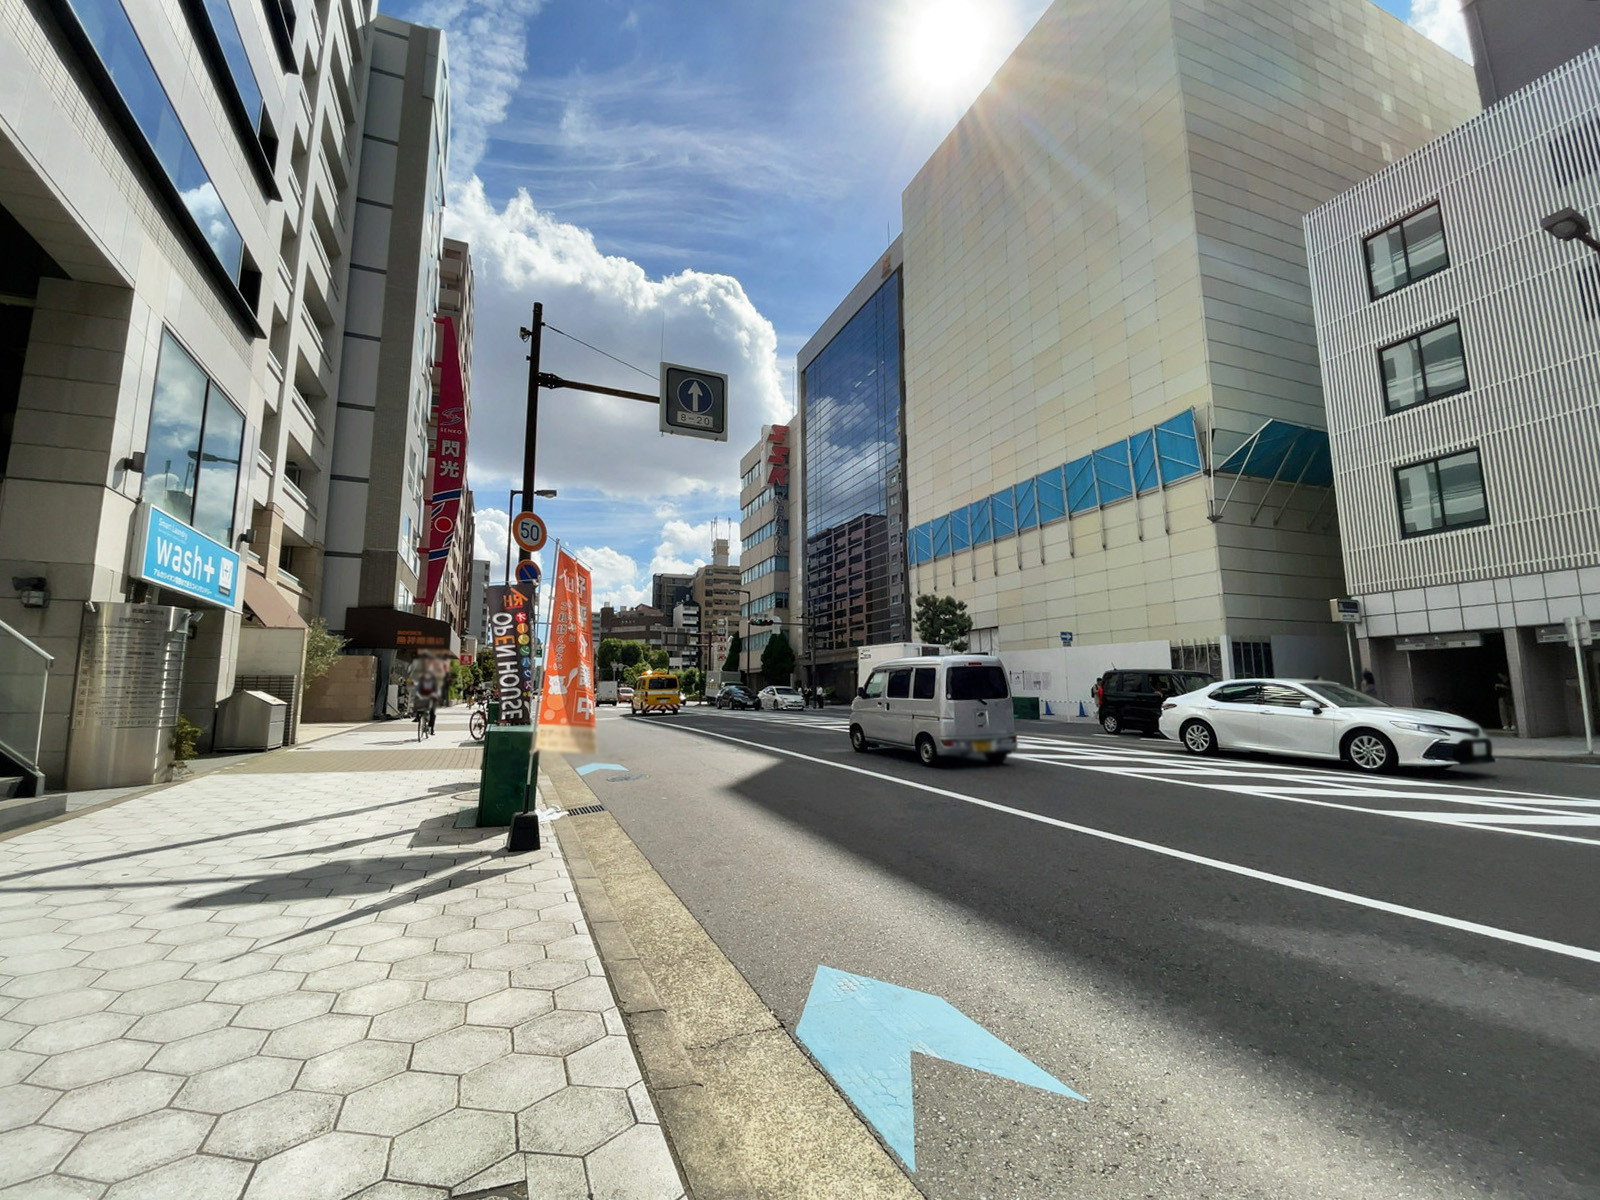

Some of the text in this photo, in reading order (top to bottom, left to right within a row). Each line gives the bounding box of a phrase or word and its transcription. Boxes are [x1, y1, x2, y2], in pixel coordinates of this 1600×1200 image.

[680, 413, 710, 426] 8-20
[440, 427, 462, 435] SENKO
[440, 439, 461, 479] 閃光
[520, 522, 539, 542] 50
[157, 536, 215, 583] wash+
